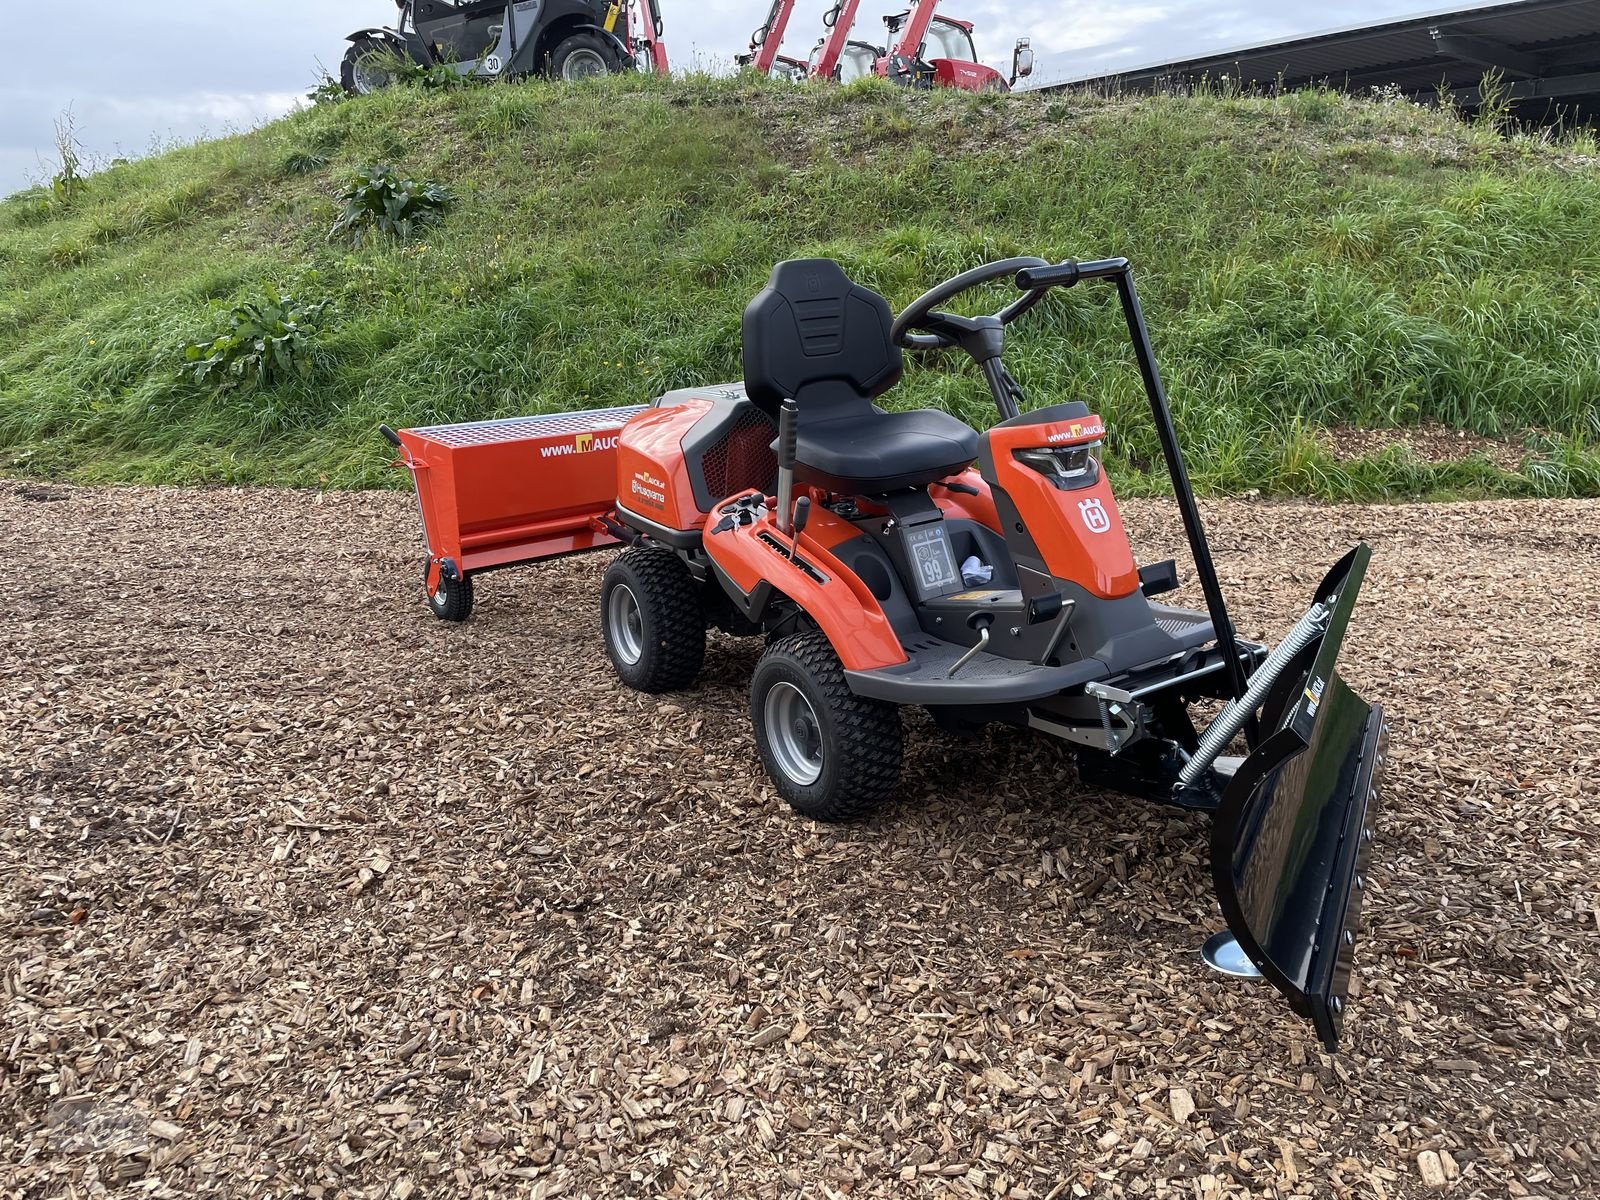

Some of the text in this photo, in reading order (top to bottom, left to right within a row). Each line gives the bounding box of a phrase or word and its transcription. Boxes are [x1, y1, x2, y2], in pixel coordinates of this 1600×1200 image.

[487, 58, 498, 70] 30
[540, 434, 619, 457] www.MAUC
[924, 559, 943, 582] 99
